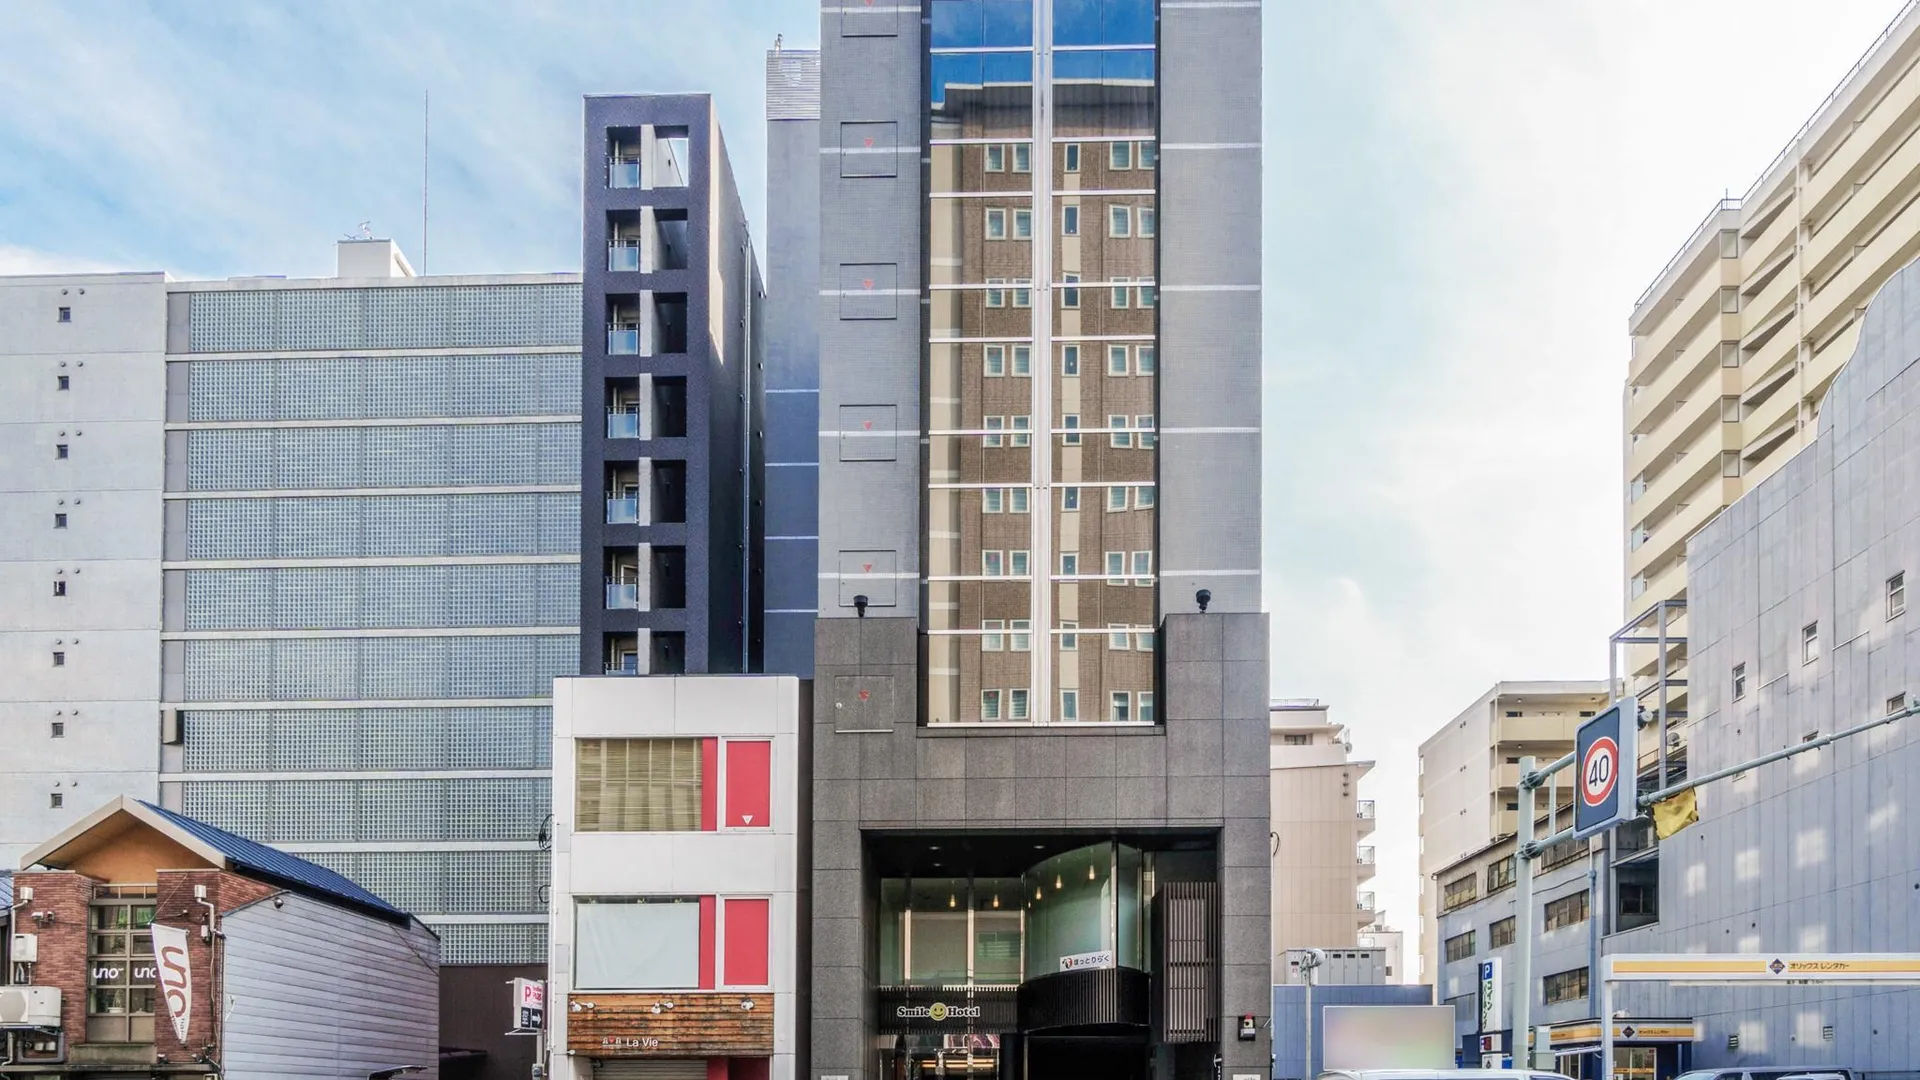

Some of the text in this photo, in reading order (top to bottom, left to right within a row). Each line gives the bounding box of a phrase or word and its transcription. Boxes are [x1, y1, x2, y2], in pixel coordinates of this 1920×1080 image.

[1589, 755, 1609, 786] 40
[1820, 962, 1850, 970] レンタカー
[93, 968, 119, 979] uno
[161, 946, 187, 1017] uno
[897, 1006, 980, 1018] Smile Hotel
[627, 1038, 639, 1047] La
[642, 1037, 658, 1047] Vie
